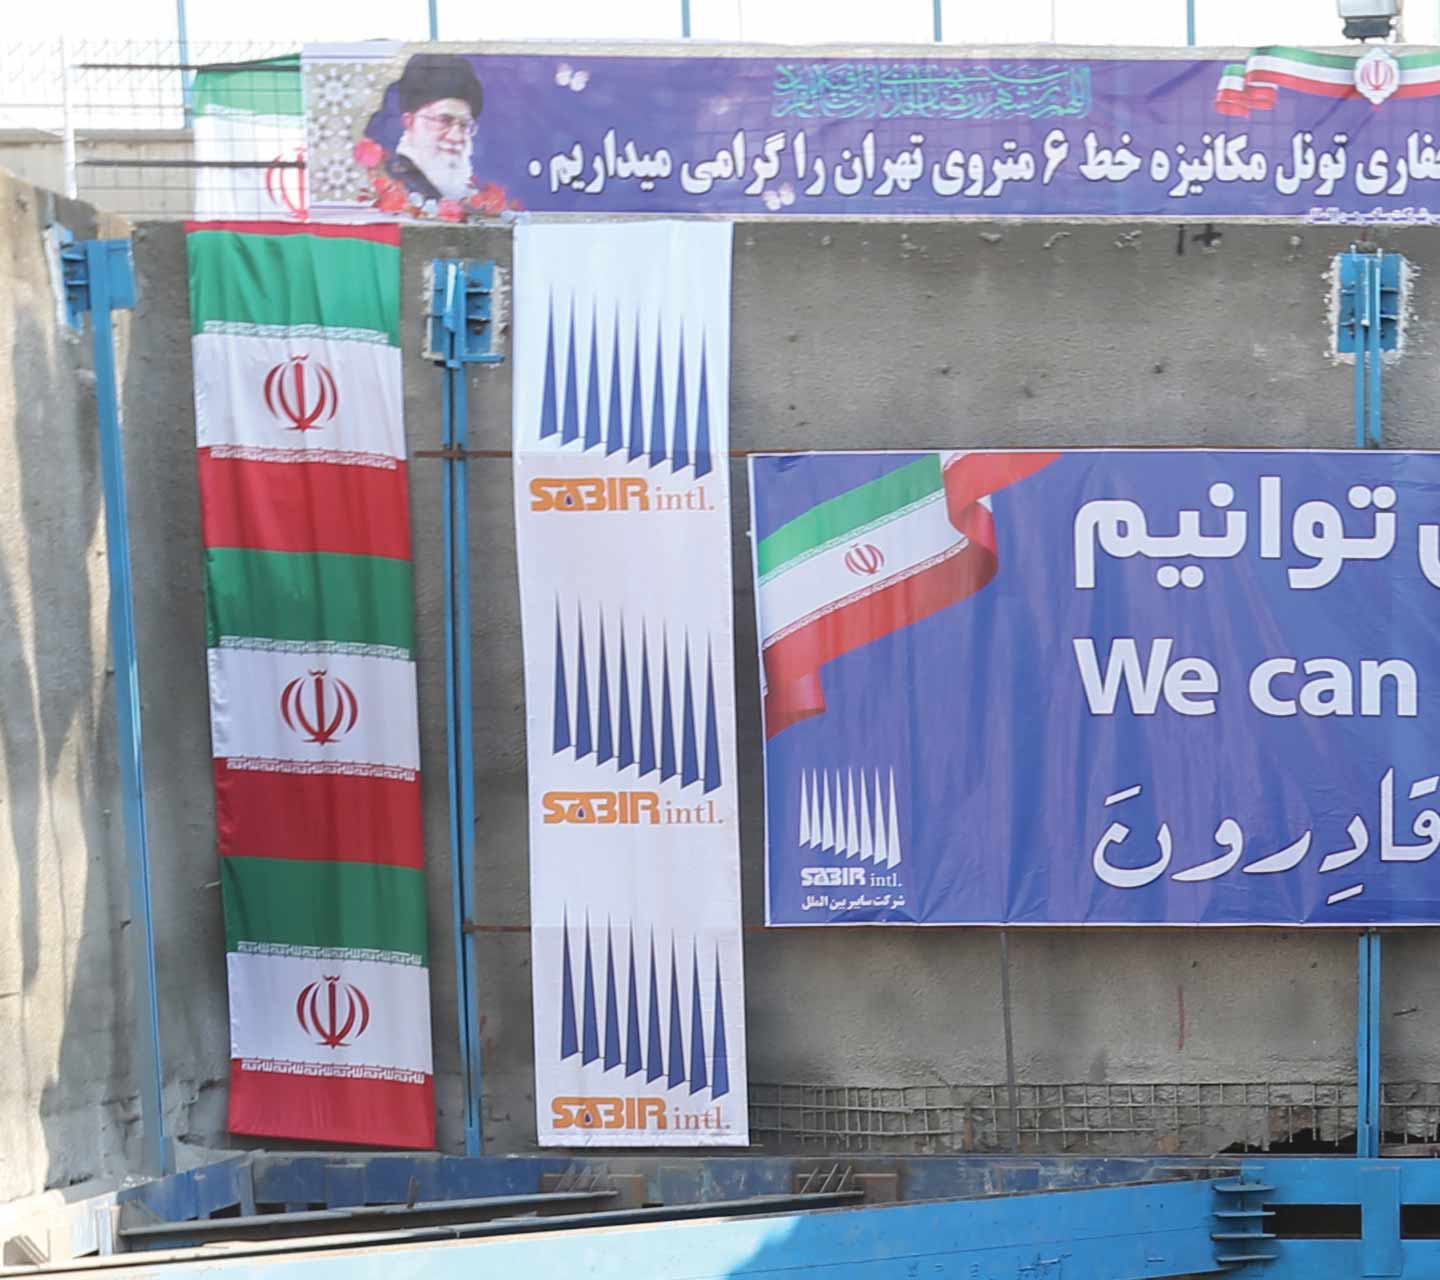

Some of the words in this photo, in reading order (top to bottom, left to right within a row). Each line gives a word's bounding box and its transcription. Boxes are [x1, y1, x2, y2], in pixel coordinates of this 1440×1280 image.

[551, 130, 671, 193] میداریم
[681, 131, 788, 194] گرامی
[794, 132, 825, 195] را
[835, 132, 924, 195] تهران
[933, 142, 1034, 196] متروی
[1043, 130, 1068, 183] ۶
[1079, 132, 1141, 181] خط
[1151, 134, 1267, 196] مکانیزه
[1276, 133, 1347, 195] تونل
[529, 475, 651, 513] SABIR
[1075, 476, 1396, 590] توانیم
[1073, 638, 1218, 716] We
[1249, 658, 1417, 717] can
[542, 790, 661, 826] SABIR
[800, 866, 866, 887] SABIR
[869, 872, 903, 888] intl.
[874, 894, 906, 909] شرکت
[550, 1096, 667, 1131] SABIR
